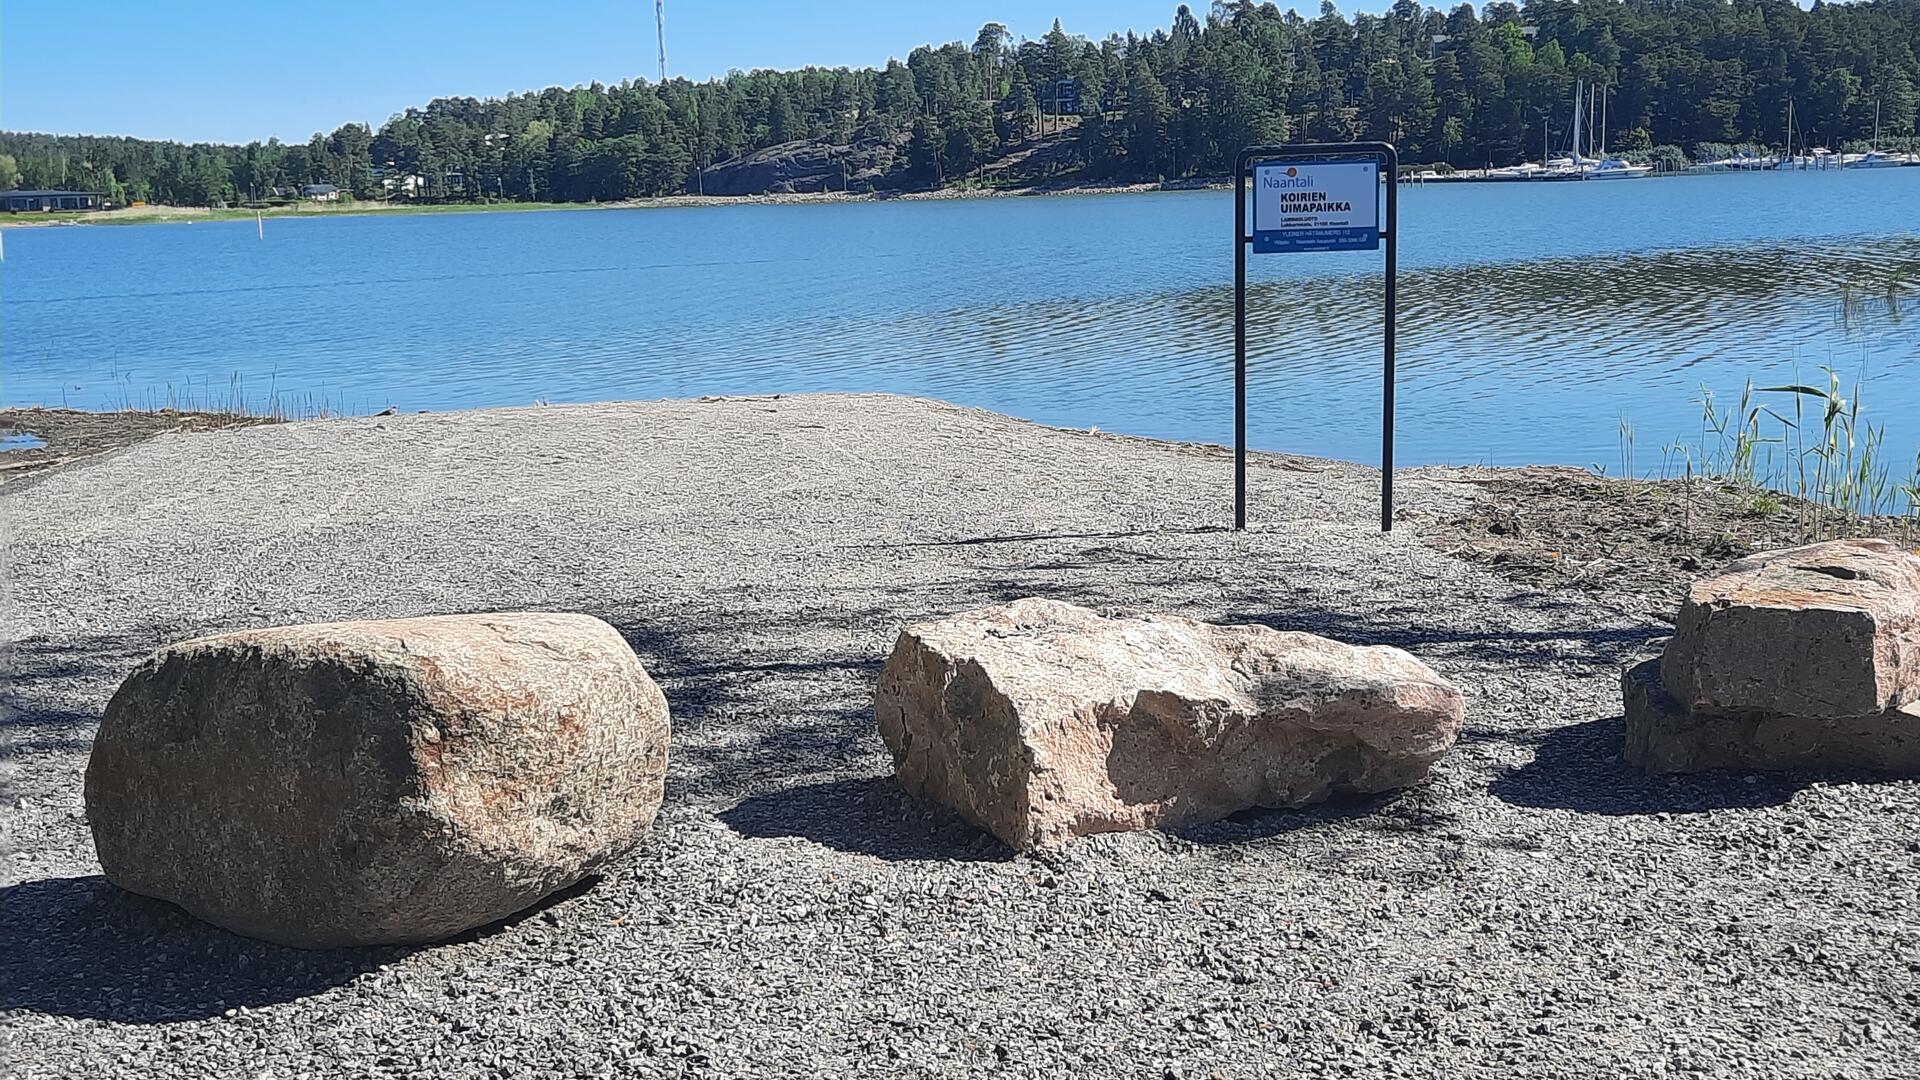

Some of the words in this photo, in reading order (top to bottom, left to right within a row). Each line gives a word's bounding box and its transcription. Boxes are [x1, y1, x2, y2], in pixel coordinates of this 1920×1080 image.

[1263, 176, 1314, 189] Naantali
[1281, 192, 1326, 202] KOIRIEN
[1281, 202, 1351, 213] UIMAPAIKKA
